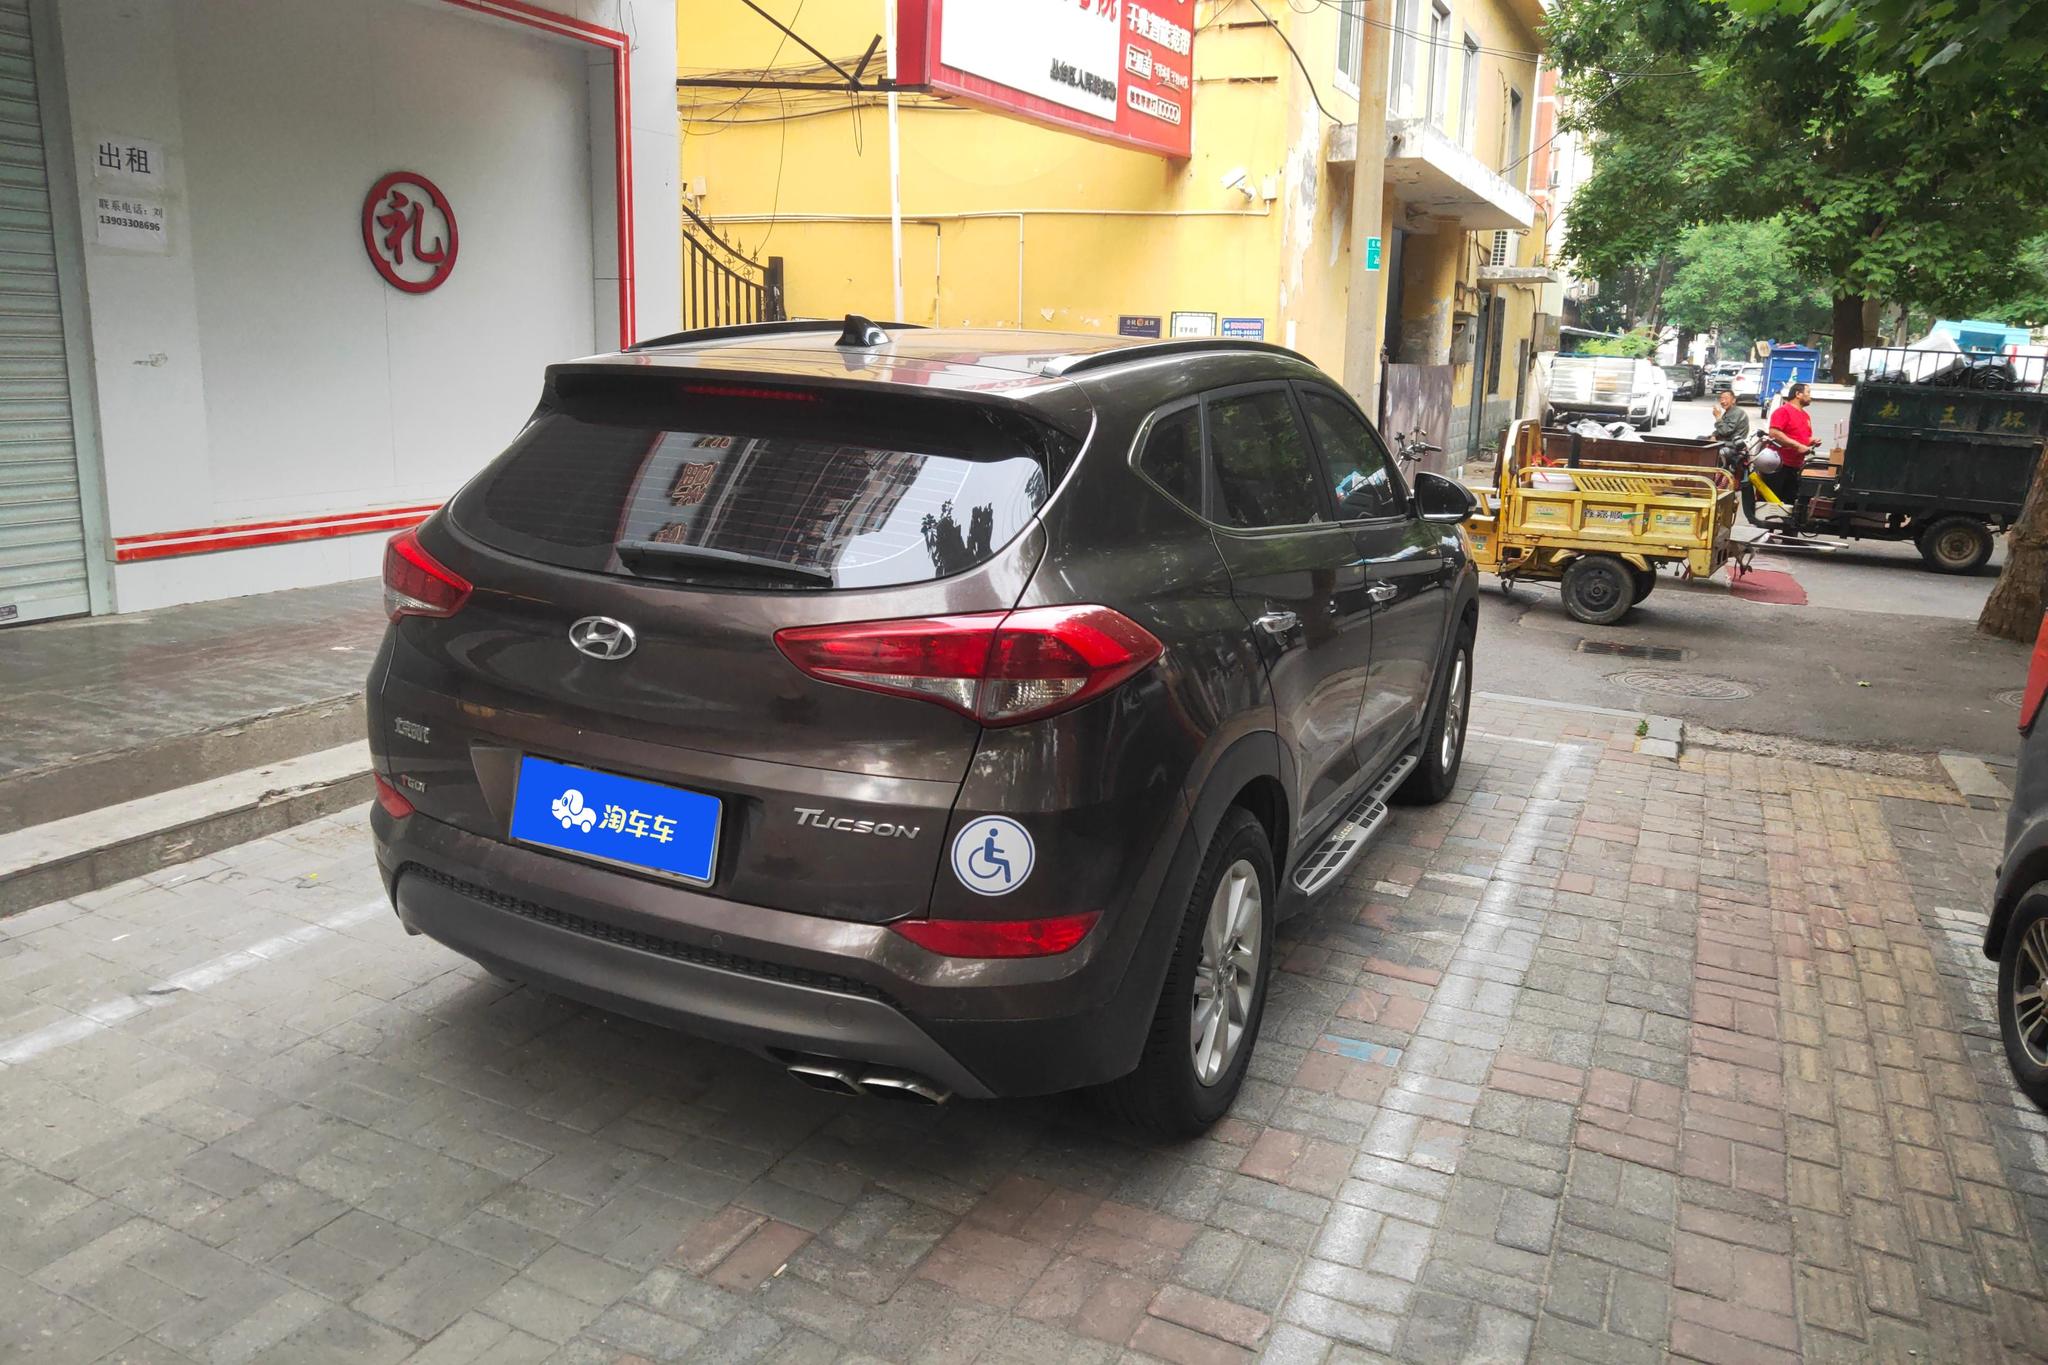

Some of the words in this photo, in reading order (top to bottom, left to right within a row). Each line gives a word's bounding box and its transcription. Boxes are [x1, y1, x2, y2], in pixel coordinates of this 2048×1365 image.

[98, 142, 151, 174] 出租
[99, 215, 161, 232] 13903308696
[376, 190, 446, 265] 礼
[793, 806, 920, 839] TUCSON
